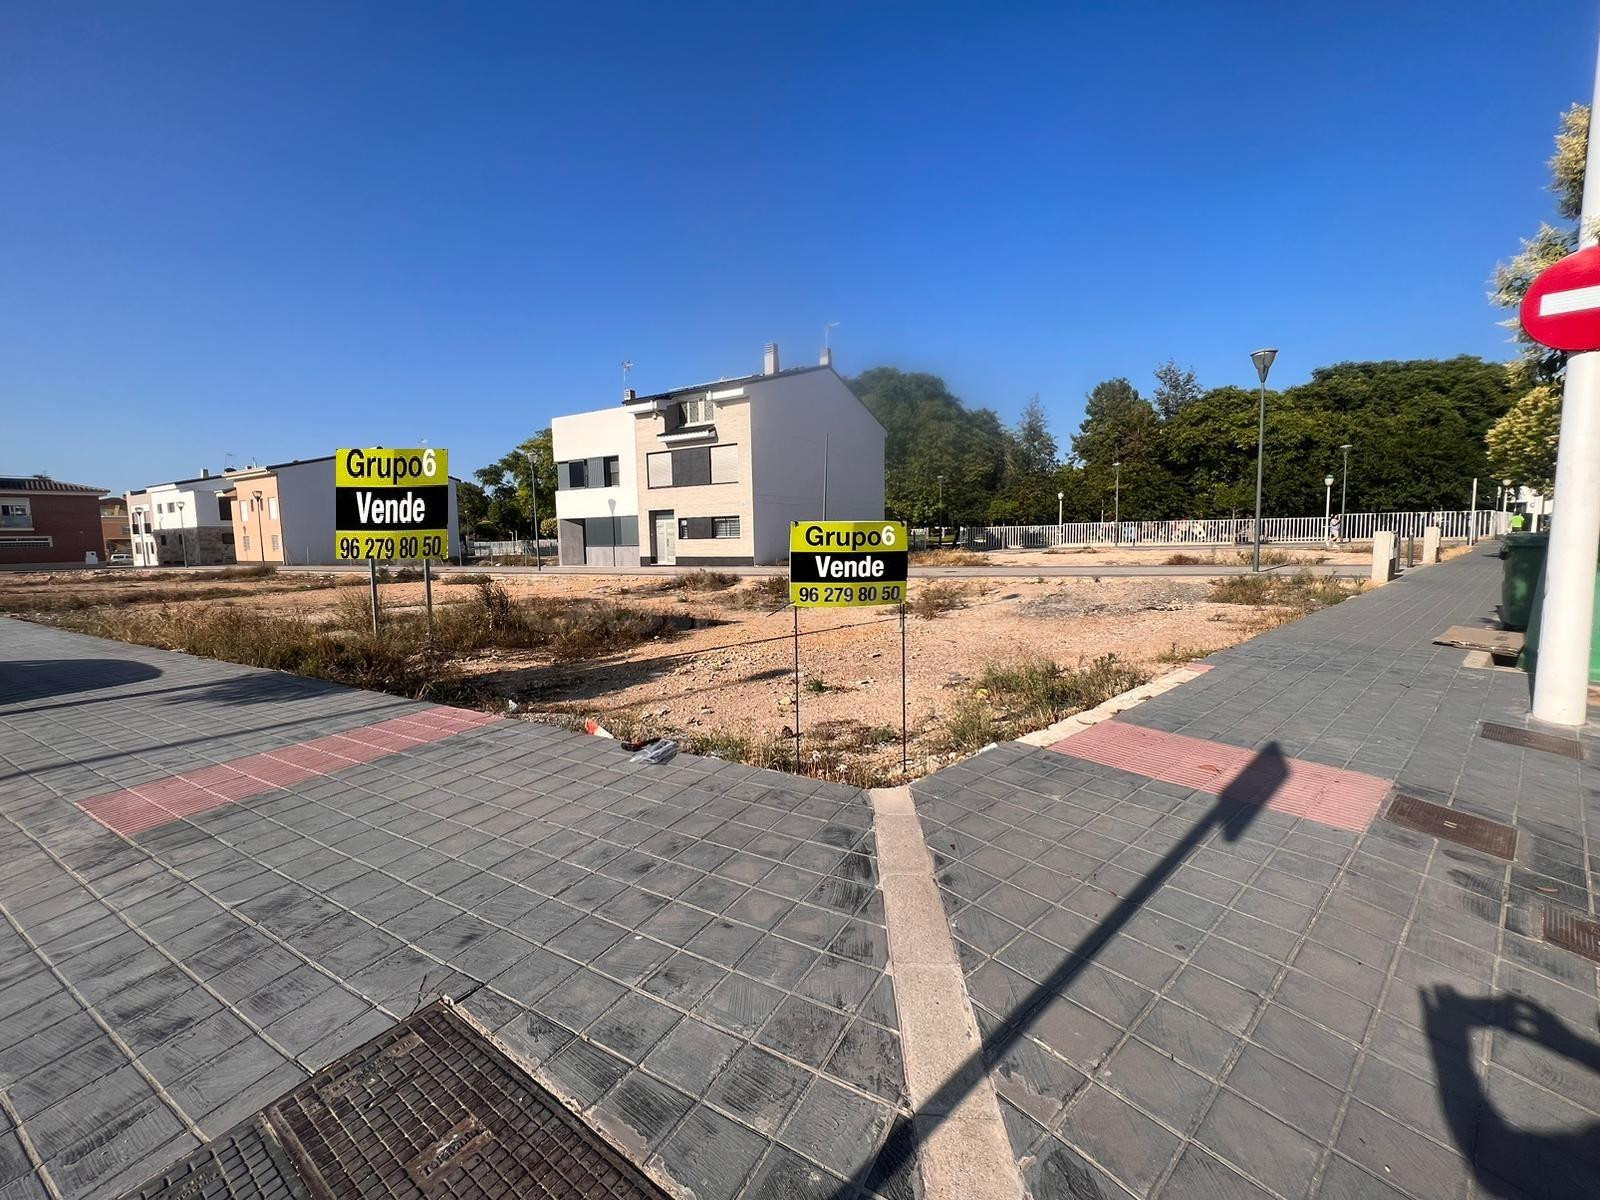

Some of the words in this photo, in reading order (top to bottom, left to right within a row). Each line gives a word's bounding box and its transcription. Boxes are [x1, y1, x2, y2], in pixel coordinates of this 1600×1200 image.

[346, 448, 437, 485] Grupo6
[356, 491, 426, 524] Vende
[340, 537, 360, 559] 96
[365, 537, 395, 559] 279
[400, 536, 418, 558] 80
[422, 535, 441, 557] 50
[805, 525, 896, 551] Grupo6
[815, 555, 885, 578] Vende
[799, 587, 819, 602] 96
[824, 587, 854, 602] 279
[858, 586, 877, 602] 80
[881, 585, 900, 601] 50
